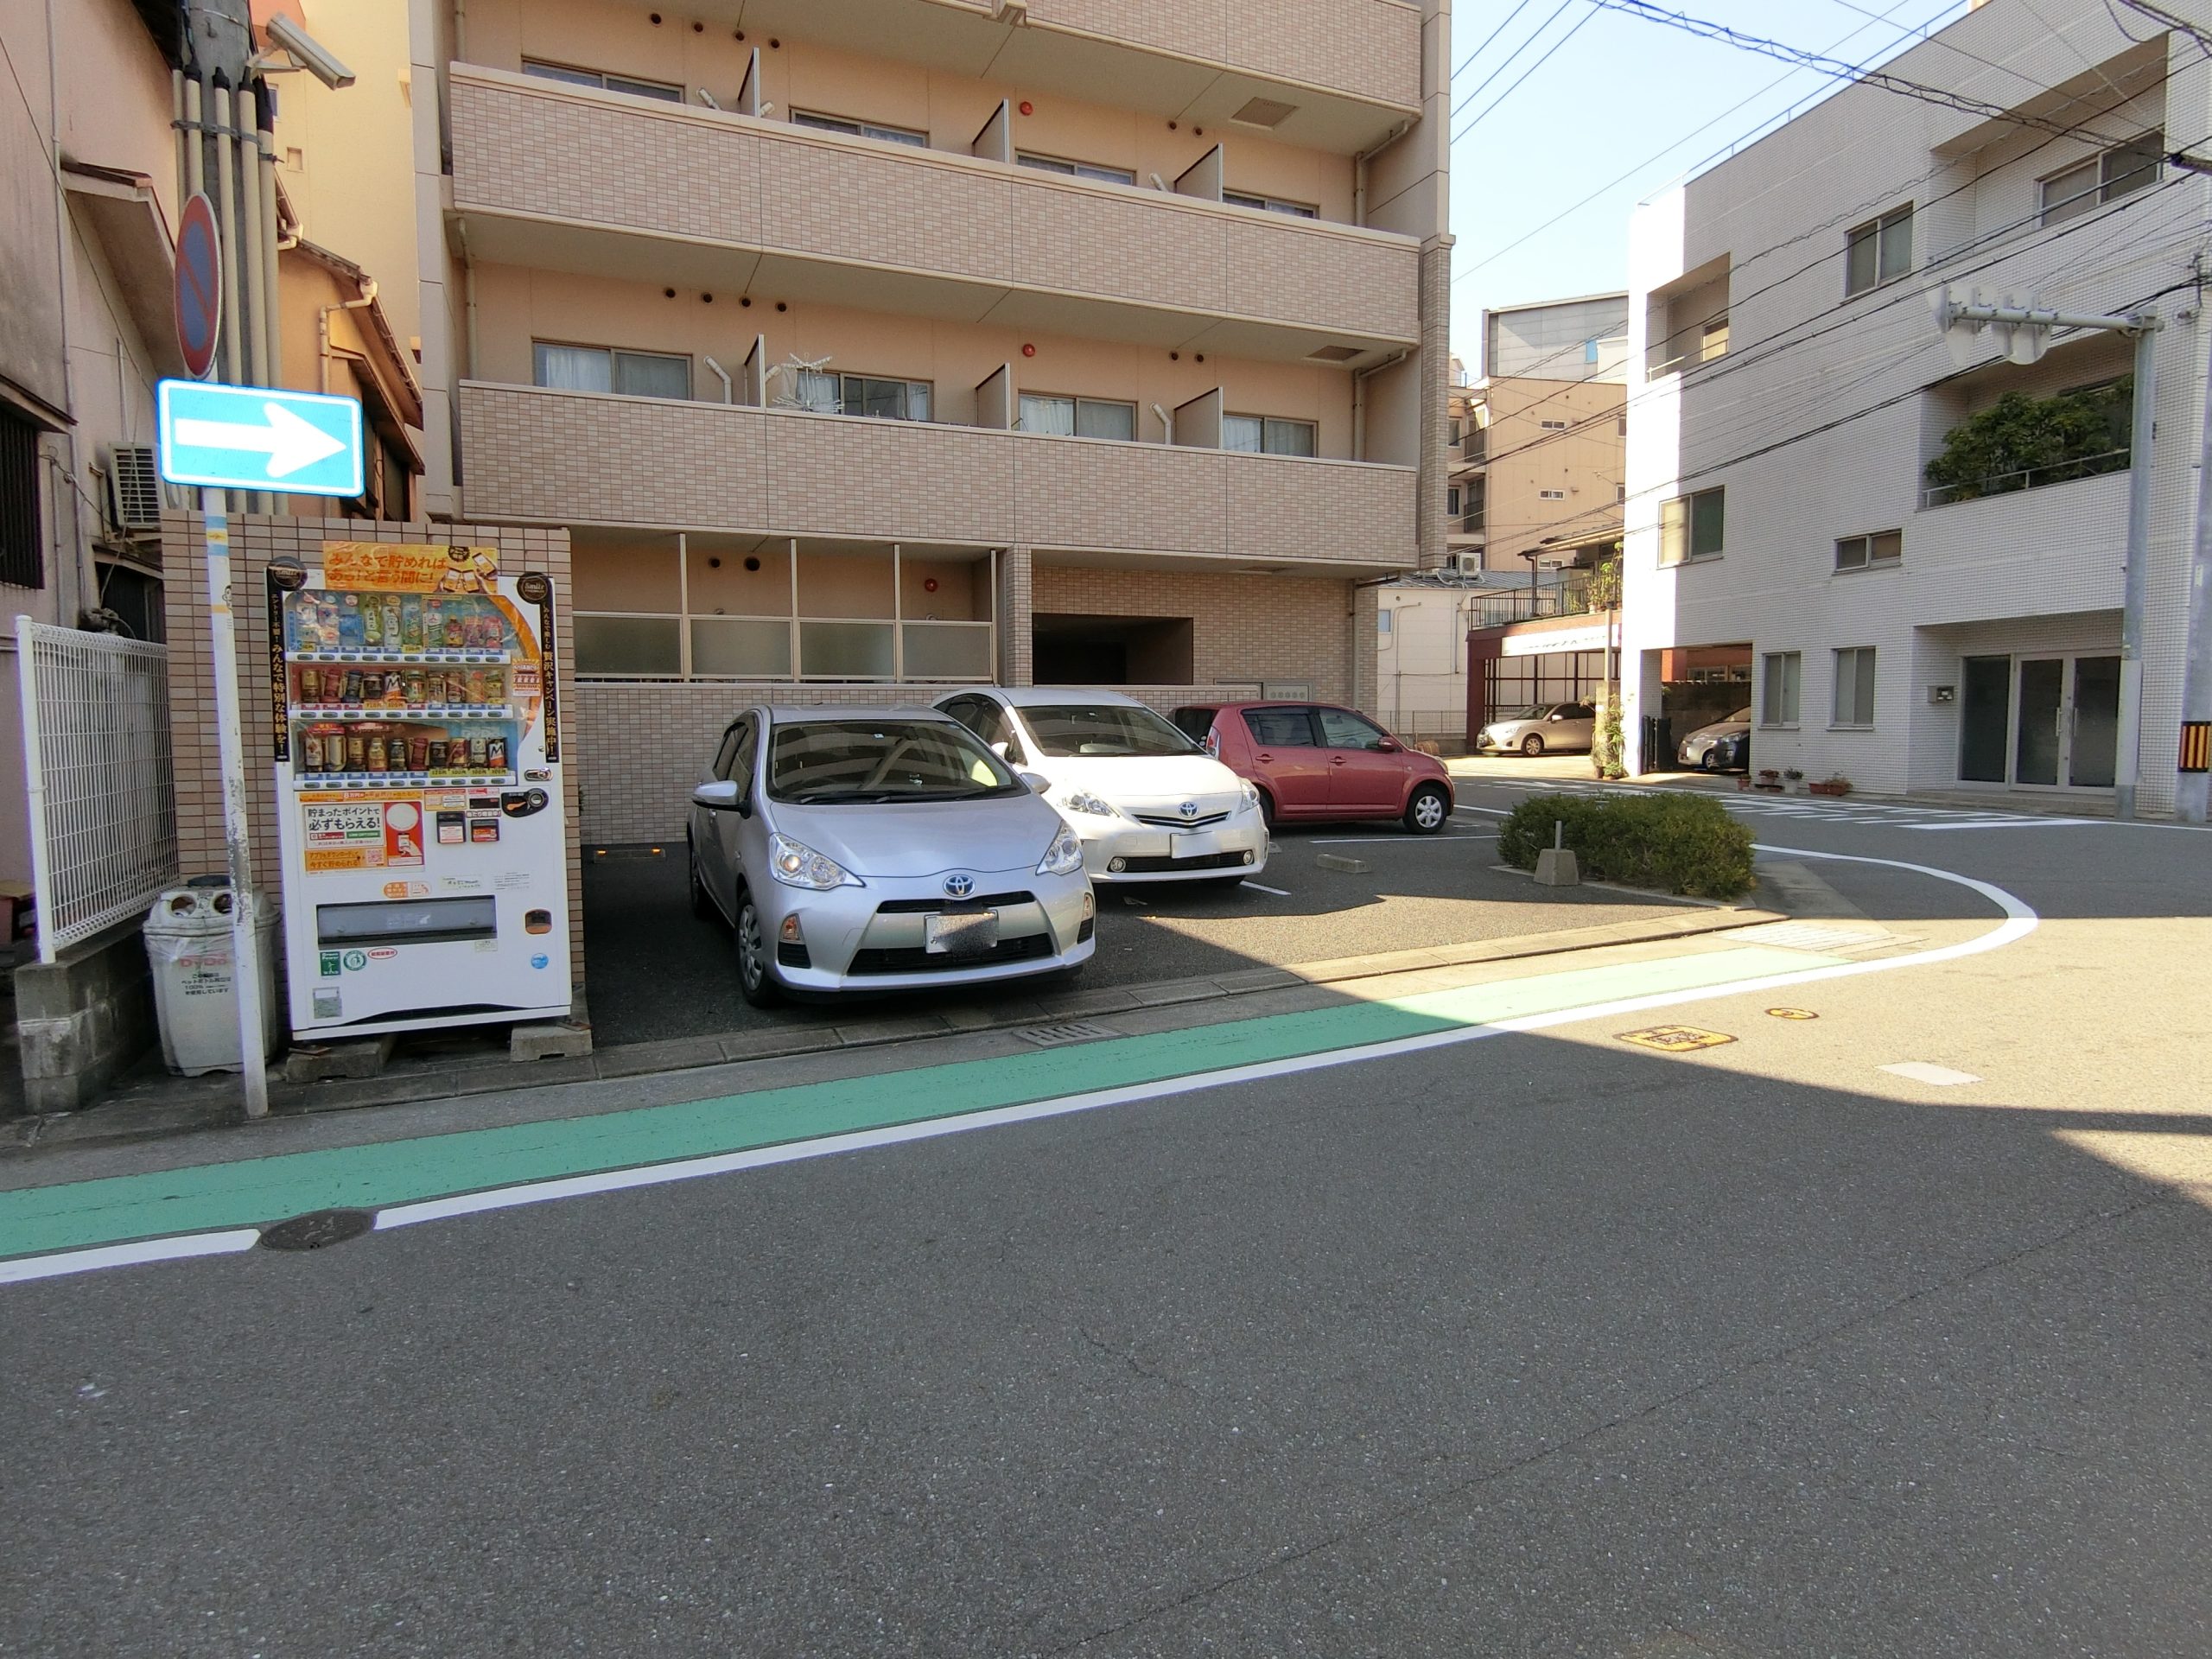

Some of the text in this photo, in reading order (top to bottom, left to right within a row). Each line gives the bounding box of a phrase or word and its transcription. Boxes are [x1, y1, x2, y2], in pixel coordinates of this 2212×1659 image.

[308, 807, 380, 818] 貯まったポイントで
[308, 817, 380, 831] 必ずもらえる!
